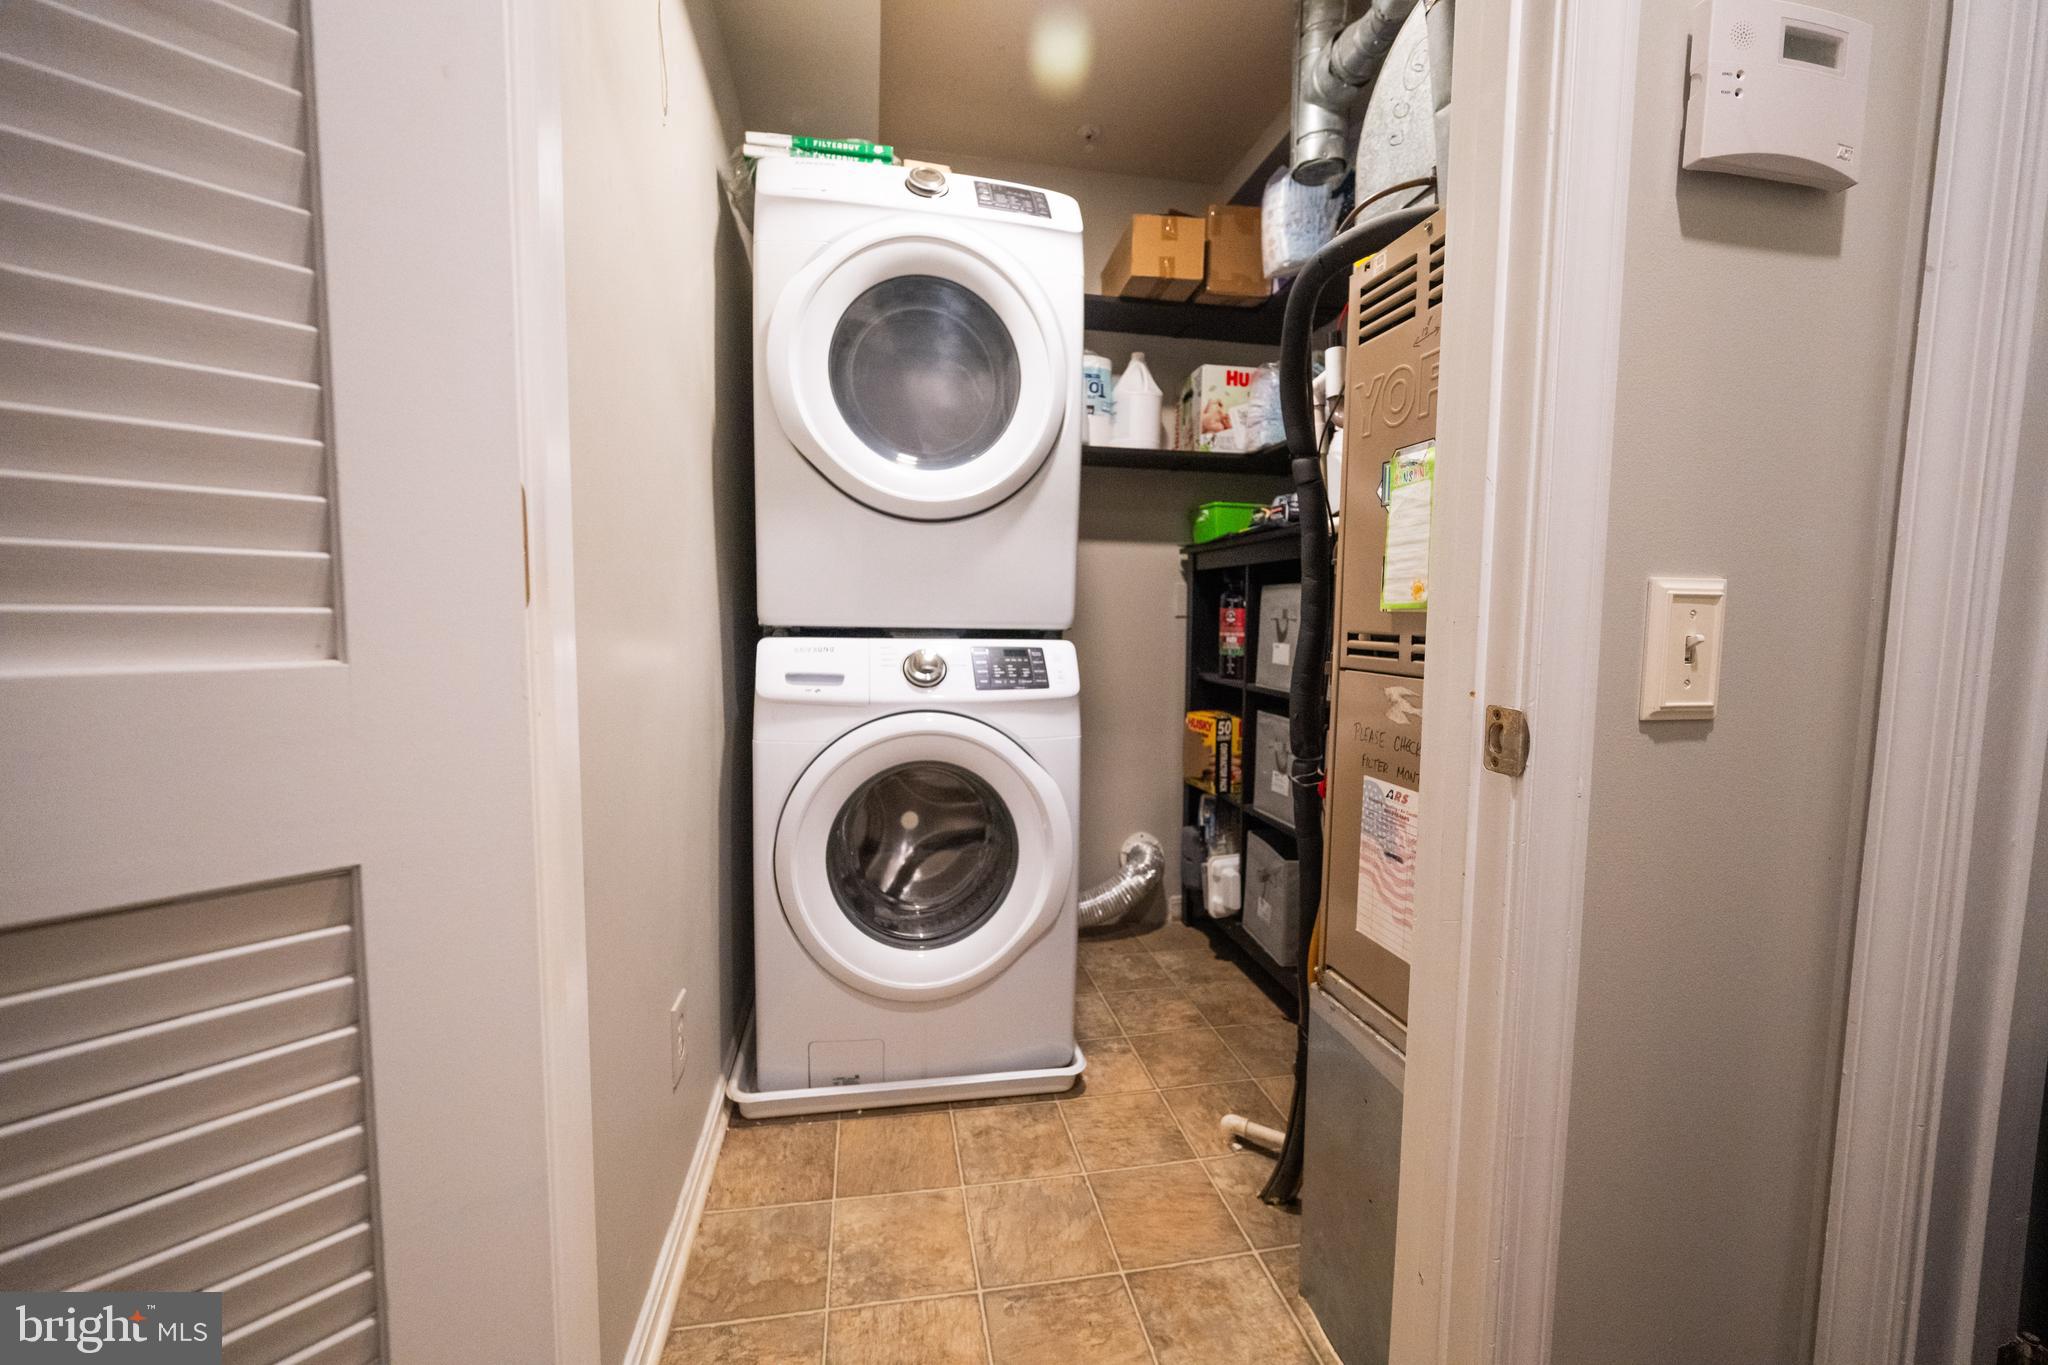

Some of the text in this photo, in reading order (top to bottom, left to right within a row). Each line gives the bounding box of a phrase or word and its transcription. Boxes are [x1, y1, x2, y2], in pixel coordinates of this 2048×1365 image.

[812, 140, 860, 151] FILTERBUY
[1217, 720, 1232, 735] 50
[1354, 722, 1386, 748] PLEASE
[1361, 753, 1388, 773] FILTER
[1385, 789, 1409, 805] ARS
